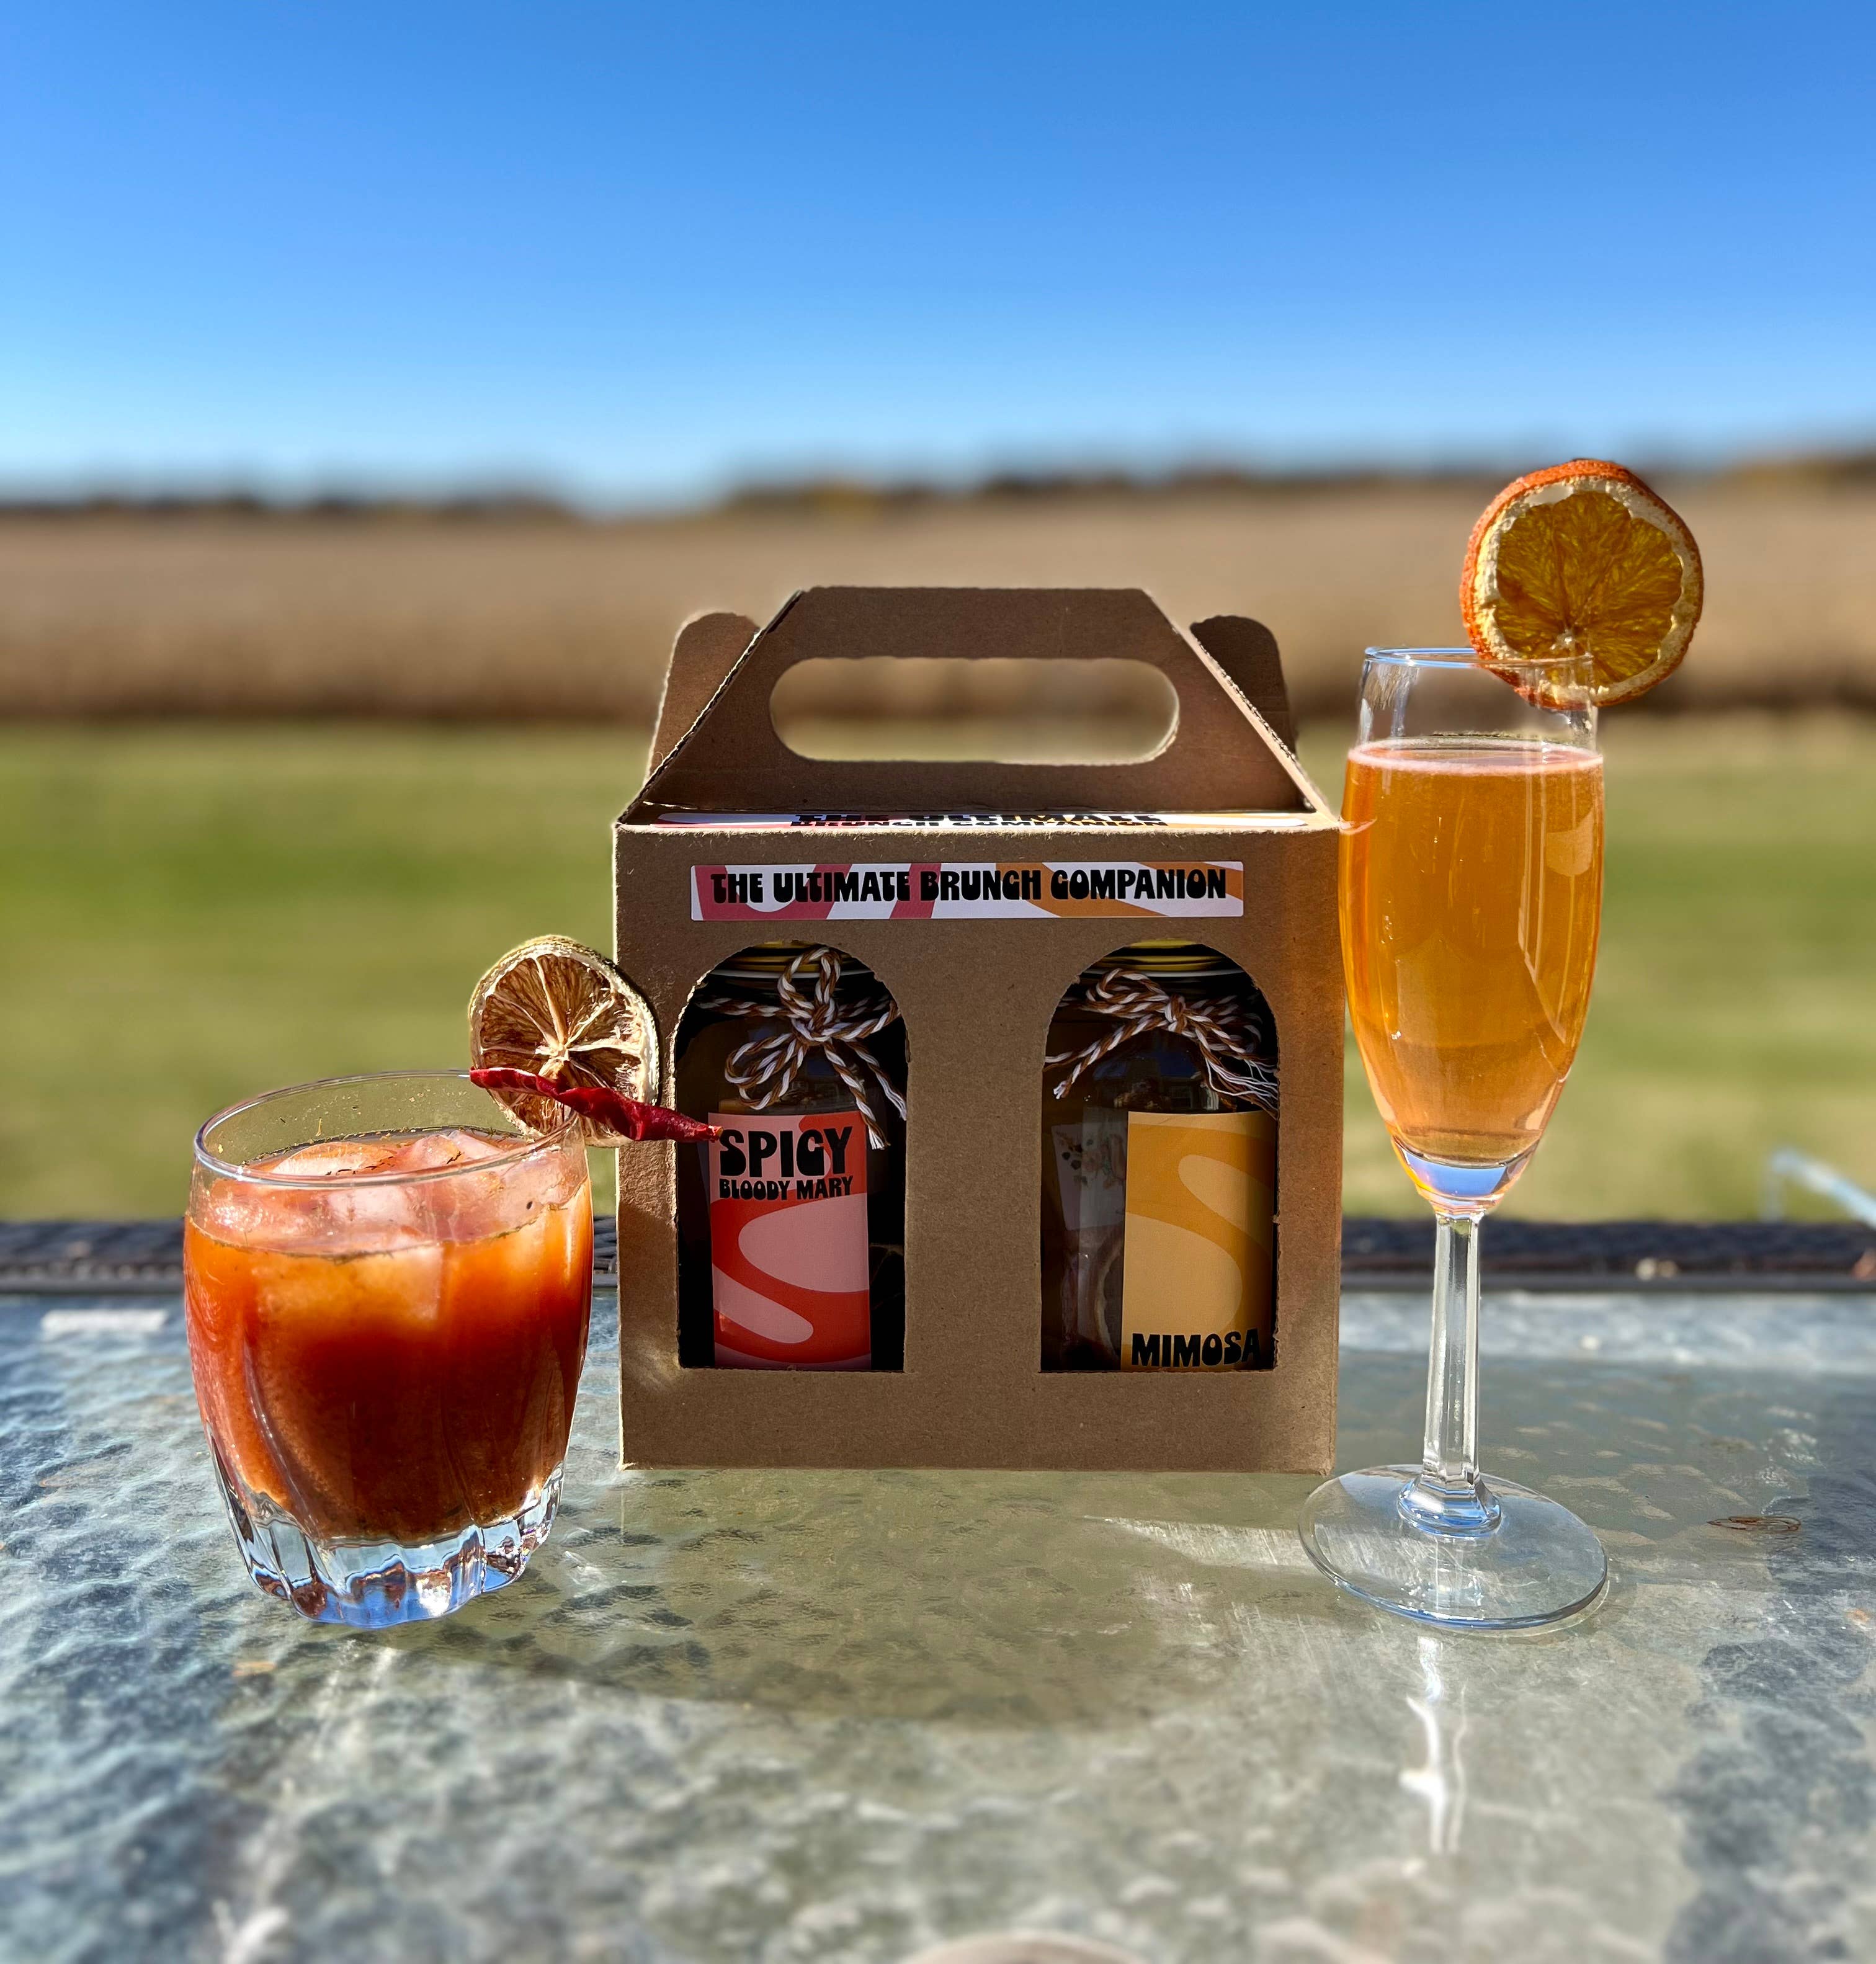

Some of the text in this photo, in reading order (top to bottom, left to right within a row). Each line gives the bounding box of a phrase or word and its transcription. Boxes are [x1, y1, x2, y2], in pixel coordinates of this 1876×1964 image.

[710, 868, 1226, 904] THE ULTIMATE BRUNCH COMPANION
[719, 1126, 853, 1178] SPICY
[719, 1176, 854, 1201] BLOODY MARY
[1131, 1328, 1261, 1368] MIMOSA
